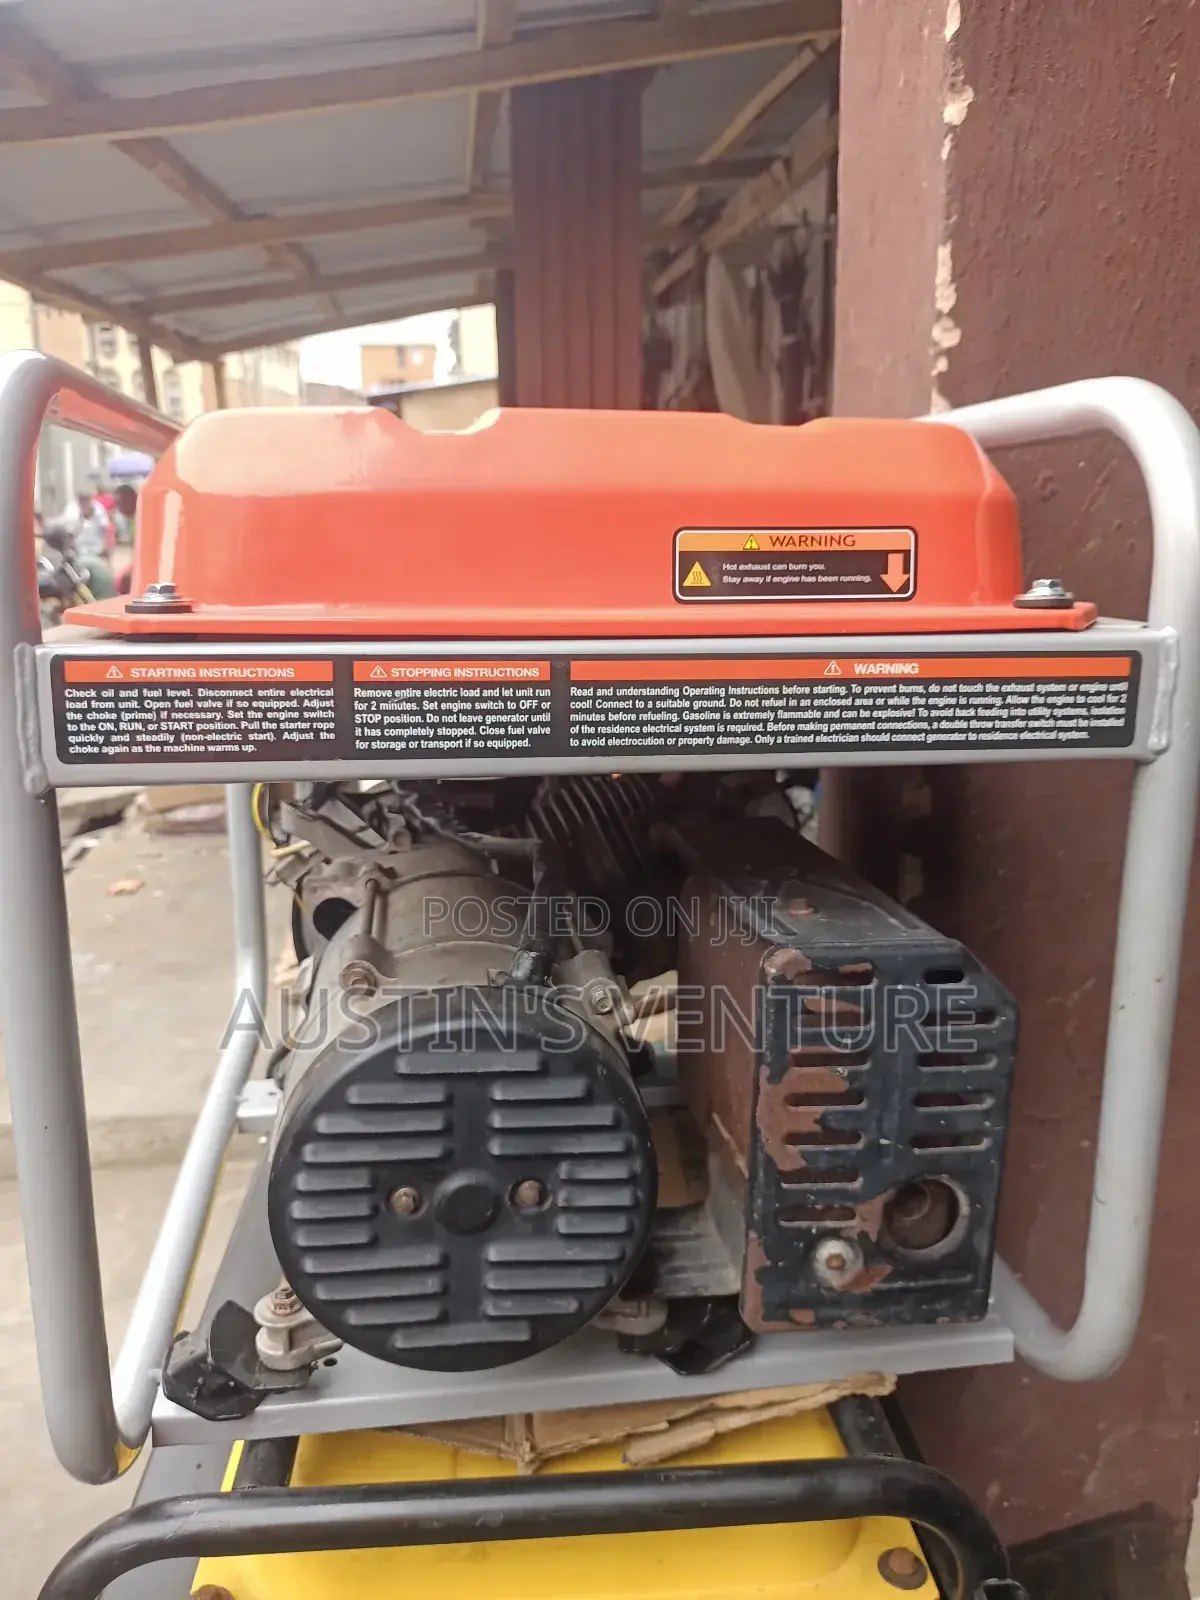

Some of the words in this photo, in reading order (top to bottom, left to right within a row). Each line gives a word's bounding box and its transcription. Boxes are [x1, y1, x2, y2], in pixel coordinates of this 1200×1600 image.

[769, 534, 855, 548] WARNING
[722, 562, 737, 571] Hot
[738, 562, 770, 571] exhaust
[771, 563, 787, 571] can
[788, 562, 807, 571] burn
[808, 563, 824, 572] you.
[722, 574, 741, 585] Stay
[742, 576, 764, 585] away
[765, 574, 771, 583] if
[772, 574, 800, 584] engine
[800, 574, 816, 583] has
[817, 574, 838, 583] been
[839, 574, 871, 584] running.
[130, 667, 196, 678] STARTING
[199, 667, 294, 678] INSTRUCTIONS
[391, 667, 451, 678] STOPPING
[453, 667, 539, 678] INSTRUCTIONS
[853, 663, 918, 675] WARNING
[64, 688, 96, 698] Check
[100, 688, 114, 698] oil
[118, 688, 138, 698] and
[142, 688, 162, 698] fuel
[166, 688, 192, 698] level.
[197, 688, 253, 698] Disconnect
[257, 688, 285, 698] entire
[289, 687, 333, 698] electrical
[353, 687, 392, 698] Remove
[394, 687, 421, 698] entire
[423, 687, 457, 698] electric
[460, 687, 480, 698] load
[482, 687, 499, 698] and
[501, 687, 513, 697] let
[515, 687, 533, 697] unit
[535, 689, 550, 697] run
[570, 686, 593, 697] Read
[596, 686, 613, 697] and
[616, 686, 679, 698] understanding
[682, 685, 725, 698] Operating
[728, 685, 779, 696] Instructions
[65, 700, 87, 710] load
[90, 699, 114, 710] from
[117, 699, 140, 709] unit.
[143, 699, 171, 711] Open
[173, 699, 193, 709] fuel
[195, 699, 222, 709] valve
[225, 699, 233, 709] if
[235, 701, 249, 709] so
[251, 698, 299, 710] equipped.
[302, 698, 334, 710] Adjust
[353, 701, 368, 711] for
[370, 700, 376, 711] 2
[379, 700, 419, 711] minutes.
[422, 700, 438, 711] Set
[440, 700, 471, 712] engine
[474, 700, 504, 710] switch
[506, 700, 516, 710] to
[519, 699, 538, 710] OFF
[540, 701, 551, 710] or
[570, 699, 592, 709] cool!
[595, 698, 632, 709] Connect
[635, 698, 644, 709] to
[647, 700, 652, 709] a
[655, 698, 690, 708] suitable
[692, 698, 726, 710] ground.
[729, 697, 742, 708] Do
[744, 697, 759, 708] not
[761, 697, 786, 707] refuel
[788, 697, 797, 707] in
[65, 711, 82, 721] the
[86, 710, 117, 720] choke
[120, 710, 156, 722] (prime)
[160, 710, 167, 720] if
[170, 711, 223, 721] necessary.
[226, 709, 243, 719] Set
[246, 709, 263, 719] the
[266, 709, 299, 721] engine
[302, 709, 334, 719] switch
[354, 713, 381, 724] STOP
[383, 713, 424, 725] position.
[426, 713, 439, 723] Do
[441, 712, 457, 723] not
[458, 712, 483, 723] leave
[484, 712, 528, 724] generator
[530, 712, 550, 722] until
[569, 711, 605, 722] minutes
[608, 711, 636, 722] before
[638, 711, 679, 723] refueling.
[682, 710, 720, 721] Gasoline
[722, 710, 731, 721] is
[732, 710, 775, 722] extremely
[66, 722, 78, 732] to
[79, 722, 96, 732] the
[97, 721, 117, 733] ON,
[118, 721, 145, 733] RUN,
[146, 723, 158, 731] or
[159, 721, 193, 731] START
[195, 721, 238, 732] position.
[240, 720, 259, 731] Pull
[261, 720, 277, 730] the
[279, 720, 311, 730] starter
[312, 722, 334, 731] rope
[354, 726, 362, 736] it
[363, 726, 381, 736] has
[383, 725, 434, 738] completely
[436, 725, 476, 737] stopped.
[479, 725, 505, 736] Close
[507, 725, 524, 735] fuel
[527, 725, 550, 735] valve
[569, 724, 579, 734] of
[581, 724, 595, 734] the
[597, 724, 640, 734] residence
[642, 723, 682, 734] electrical
[683, 723, 715, 735] system
[716, 723, 725, 733] is
[726, 723, 764, 735] required.
[766, 722, 795, 733] Before
[67, 732, 104, 744] quickly
[110, 732, 130, 742] and
[135, 732, 174, 744] steadily
[180, 731, 242, 743] (non-electric
[247, 731, 276, 743] start).
[282, 731, 314, 742] Adjust
[319, 731, 335, 741] the
[355, 739, 369, 749] for
[370, 738, 406, 751] storage
[408, 740, 418, 749] or
[420, 738, 463, 750] transport
[464, 738, 471, 748] if
[473, 740, 484, 748] so
[486, 737, 530, 750] equipped.
[569, 737, 579, 747] to
[581, 736, 605, 747] avoid
[607, 735, 664, 746] electrocution
[666, 737, 676, 746] or
[677, 735, 714, 747] property
[716, 734, 752, 747] damage.
[754, 734, 775, 746] Only
[776, 736, 782, 744] a
[68, 744, 99, 754] choke
[101, 744, 129, 755] again
[130, 745, 143, 754] as
[144, 743, 161, 753] the
[163, 743, 205, 753] machine
[207, 744, 239, 753] warms
[241, 744, 257, 754] up.
